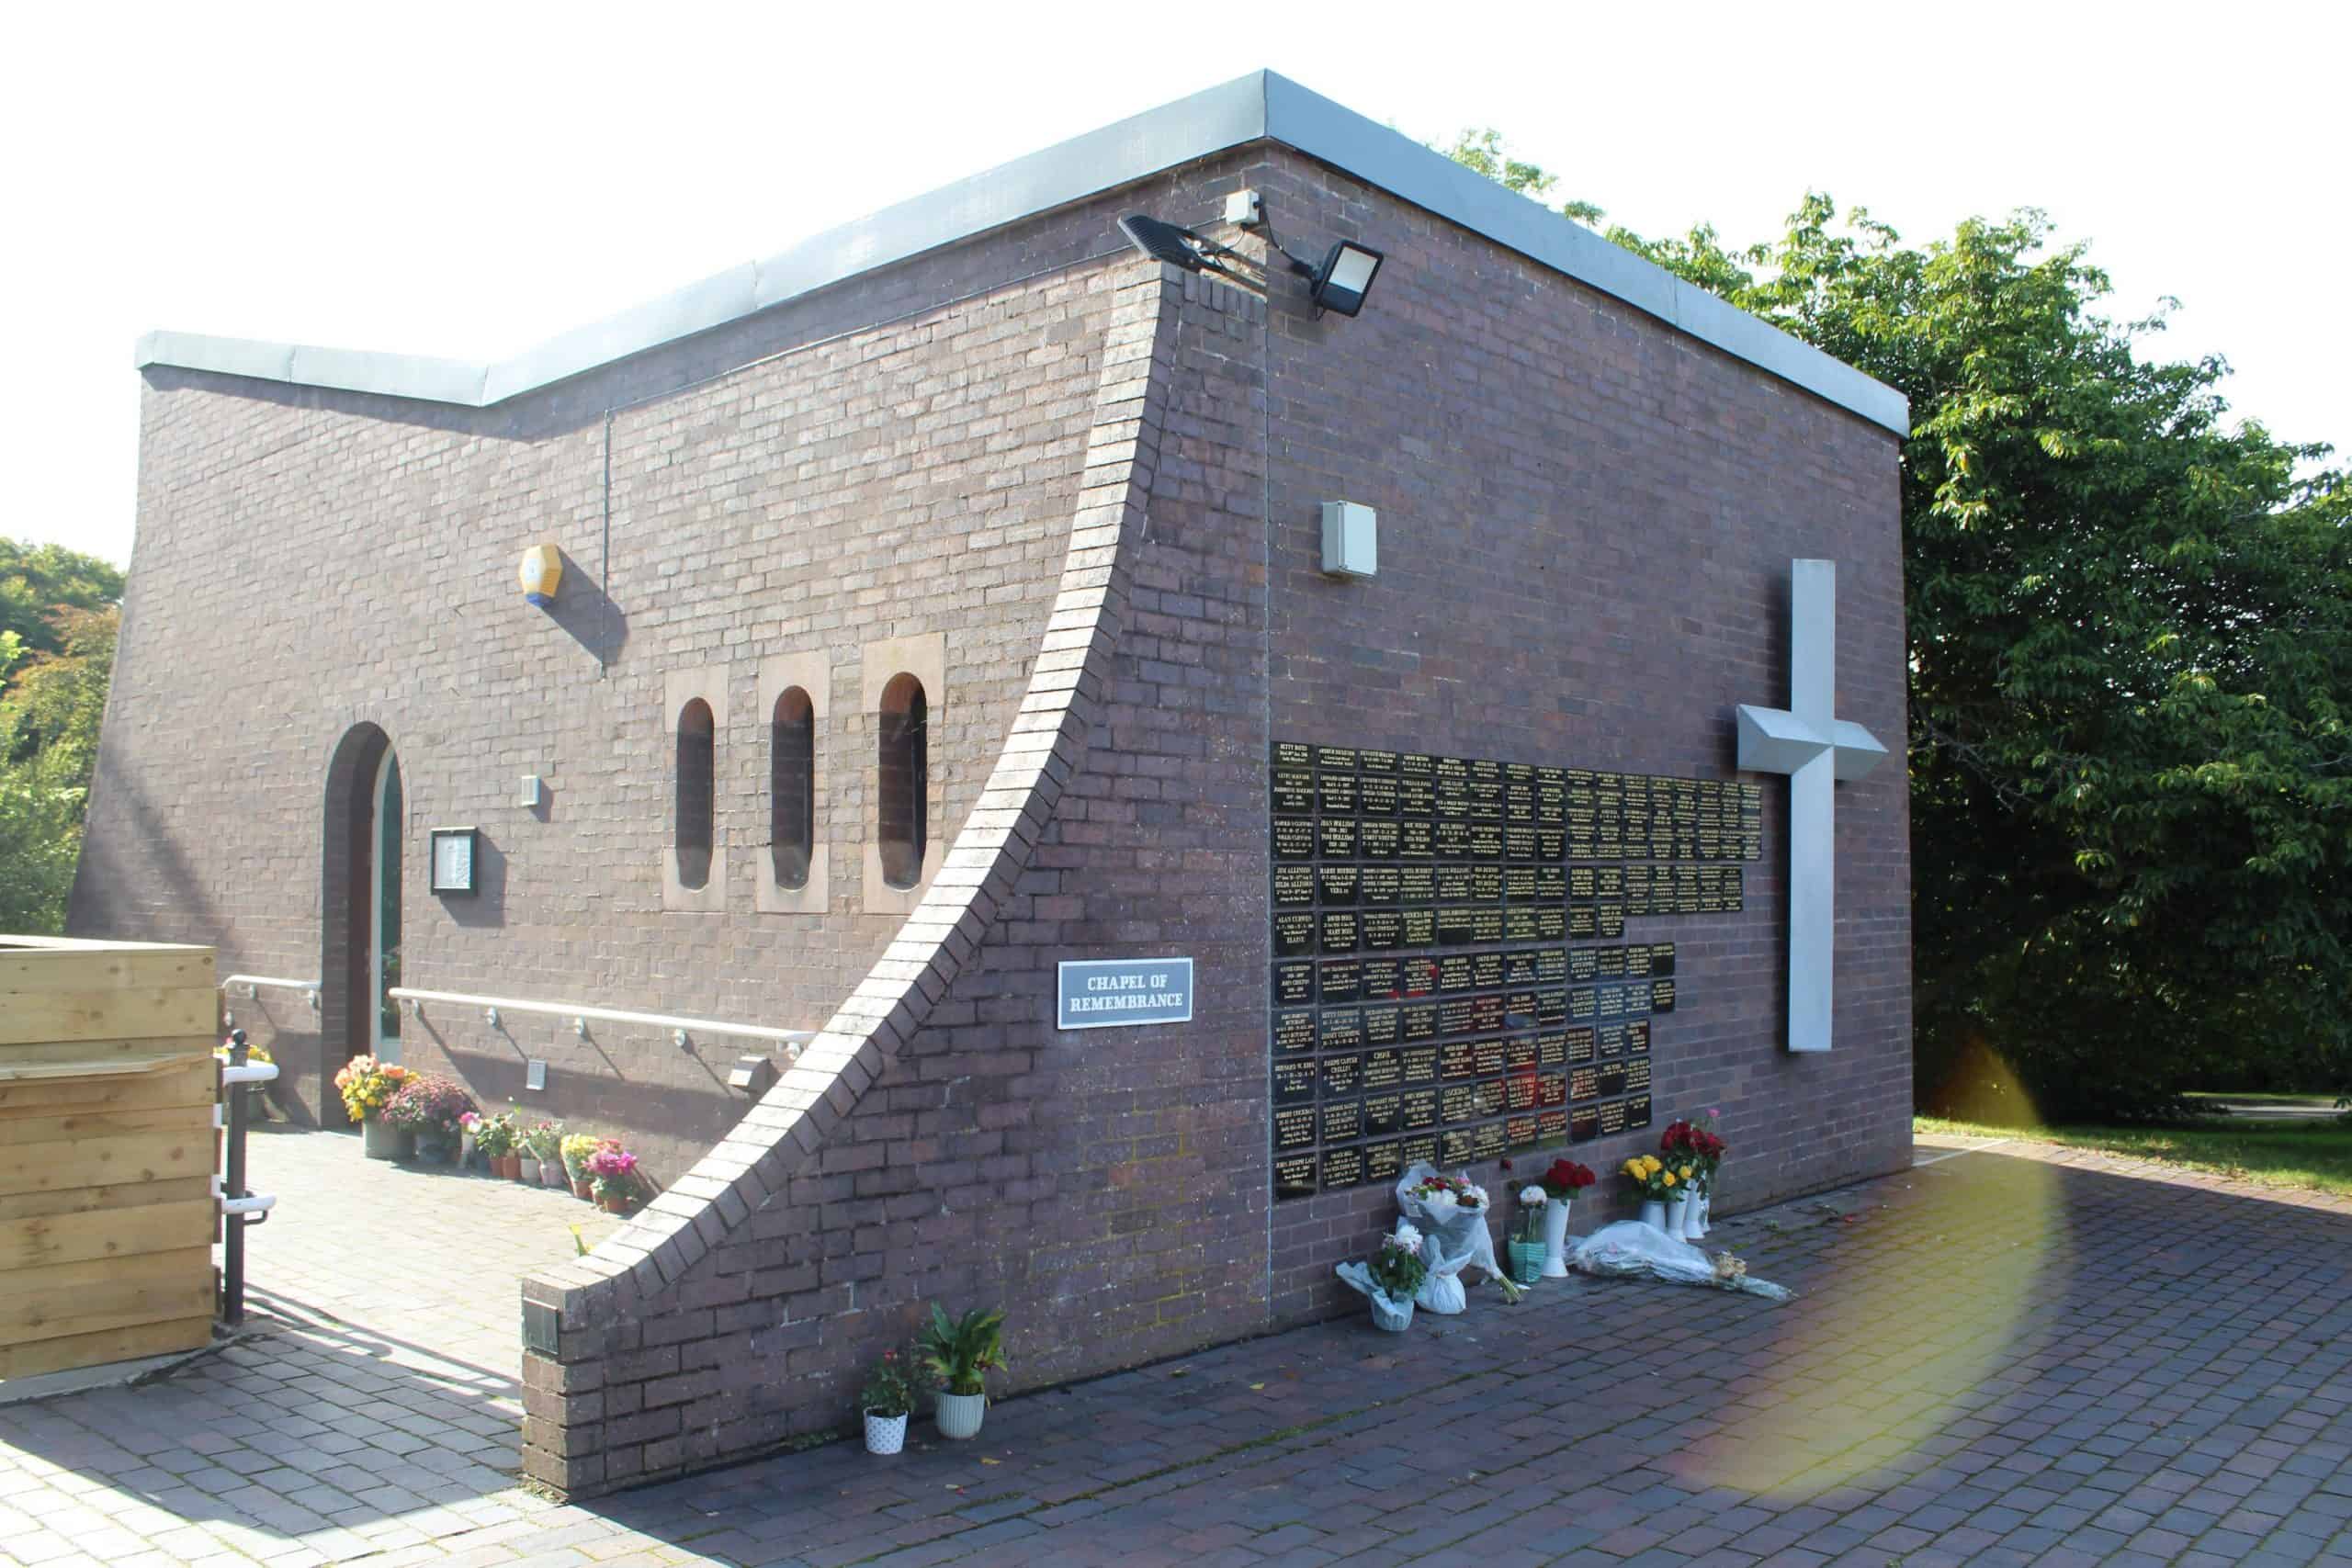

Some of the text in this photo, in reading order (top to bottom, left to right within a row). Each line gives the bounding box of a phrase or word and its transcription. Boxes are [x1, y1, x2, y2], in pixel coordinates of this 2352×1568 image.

[1087, 974, 1169, 991] CHAPEL OF
[1069, 993, 1183, 1012] REMEMBRANCE
